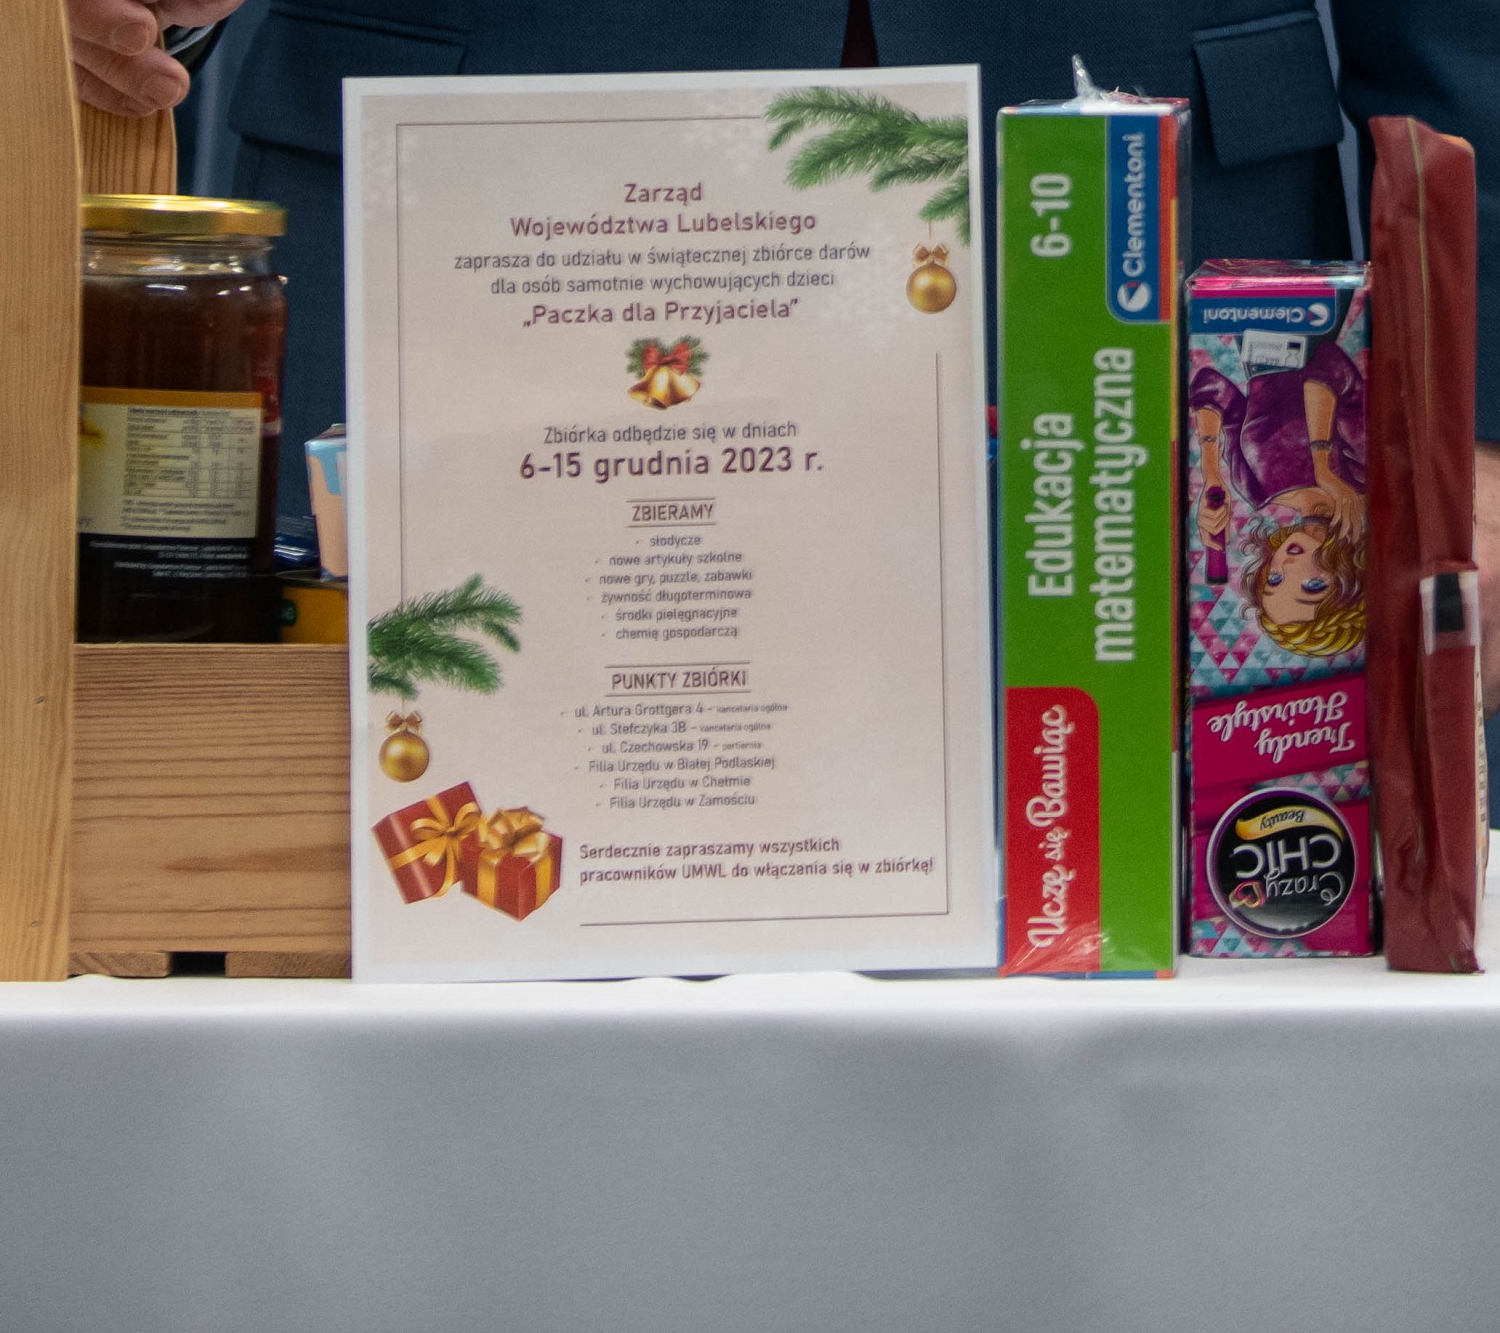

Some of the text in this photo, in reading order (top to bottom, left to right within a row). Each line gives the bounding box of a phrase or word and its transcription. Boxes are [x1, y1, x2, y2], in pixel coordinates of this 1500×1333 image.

[624, 182, 702, 206] Zarząd
[1122, 132, 1147, 277] Clementoni
[510, 210, 816, 241] Województwa Lubelskiego
[1030, 172, 1074, 258] 6-10
[454, 241, 870, 272] zaprasza do udziału w świątecznej zbiórce darów
[491, 269, 835, 294] dla osób samotnie wychowujących dzieci
[622, 303, 655, 322] dla
[1203, 306, 1305, 325] Clementoni
[544, 421, 797, 445] Zbiórka odbędzie się w dniach
[594, 448, 710, 483] grudnia
[721, 446, 793, 474] 2023
[804, 449, 824, 472] r.
[632, 503, 714, 521] ZBIERAMY
[1020, 411, 1084, 597] Edukacja
[1091, 346, 1149, 662] matematyczna
[650, 535, 701, 548] słodycze
[609, 551, 743, 568] nowe artykuły szkolne
[599, 574, 631, 585] nowe
[704, 569, 752, 582] zabawki
[655, 589, 751, 603] długoterminowa
[615, 607, 738, 623] środki pielęgnacyjne
[616, 625, 738, 641] chemię gospodarczą
[611, 667, 746, 691] PUNKTY ZBIÓRKI
[592, 705, 631, 717] Artura
[635, 703, 692, 718] Grottgera
[1206, 690, 1350, 742] Hairstyle
[610, 722, 668, 738] Stefczyka
[620, 740, 694, 753] Czechowska
[1256, 720, 1357, 765] Trendy
[589, 755, 775, 774] Filia Urzędu w Białej Podlaskiej
[614, 775, 750, 792] Filia Urzędu w Chełmie
[610, 793, 755, 810] Filia Urzędu w Zamościu
[1025, 703, 1077, 949] Uczę się Bawiąc
[1259, 805, 1307, 831] Beauty
[580, 836, 840, 859] Serdecznie zapraszamy wszystkich
[1229, 833, 1342, 879] CHIC
[580, 855, 934, 885] pracowników UMWL do włączenia się w zbiórkę!
[1264, 871, 1346, 907] Crazy
